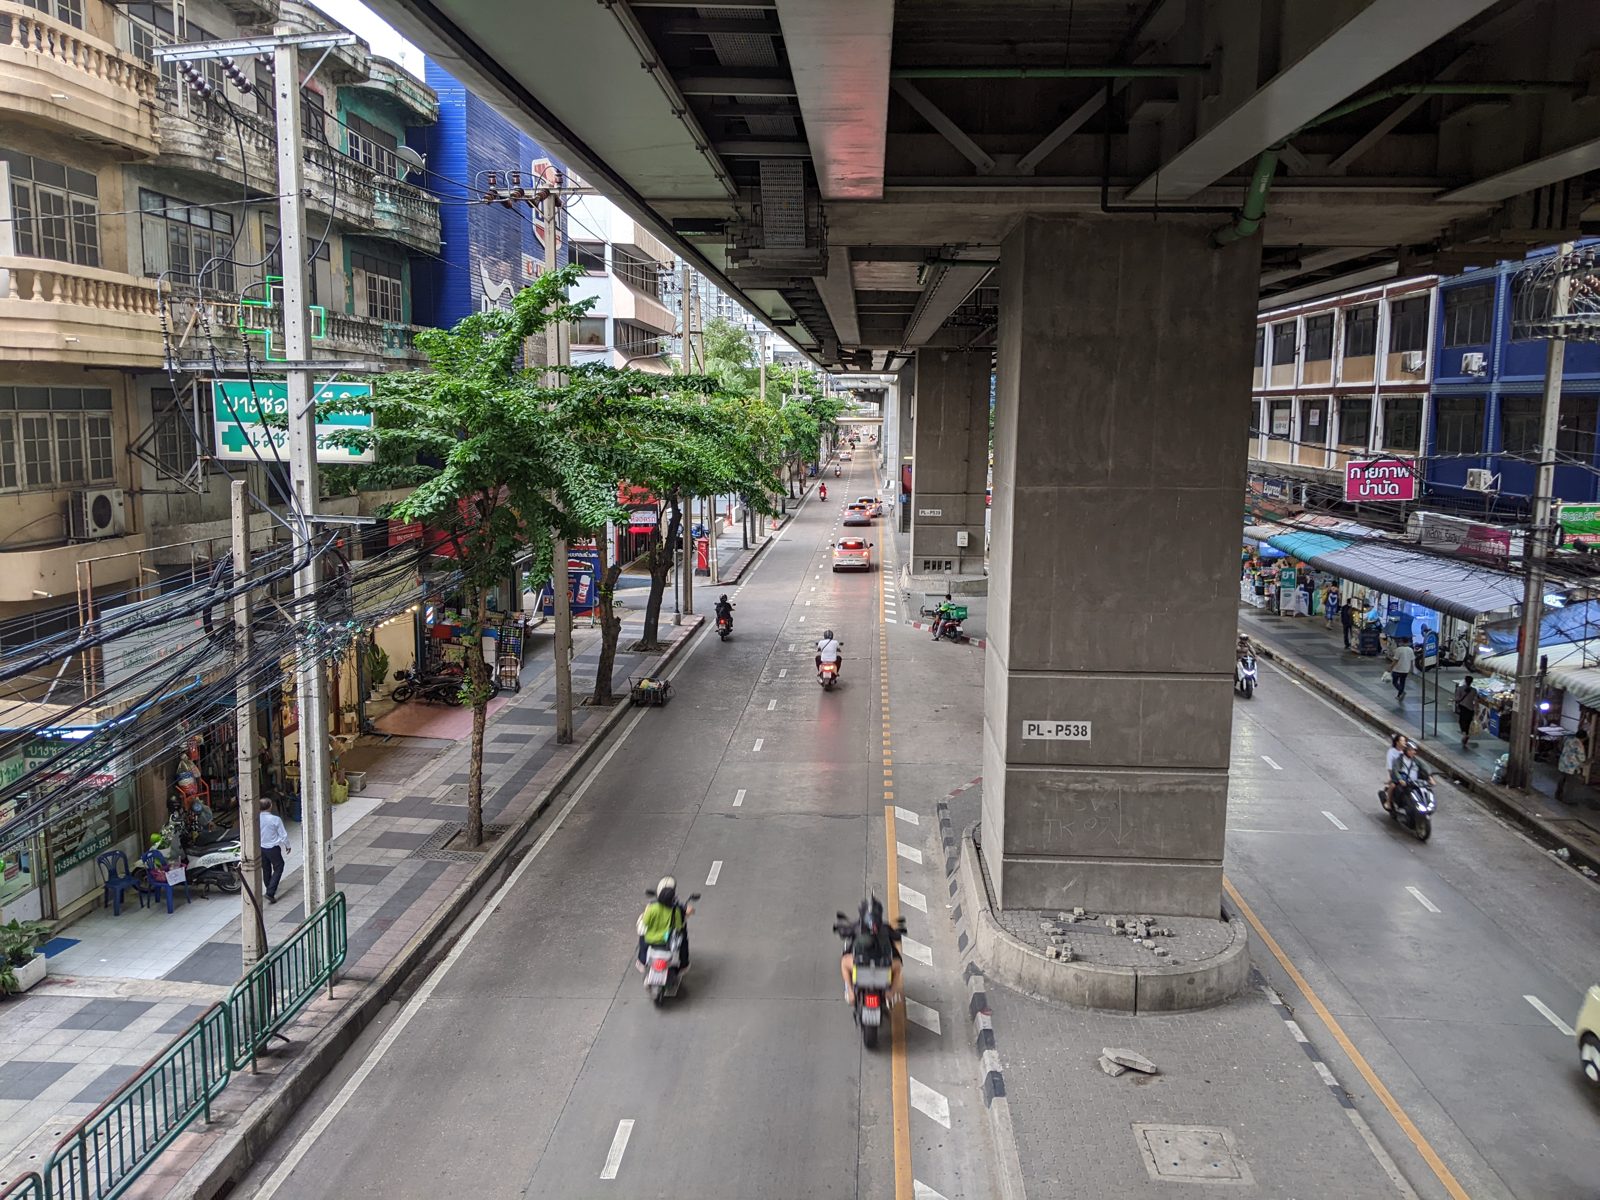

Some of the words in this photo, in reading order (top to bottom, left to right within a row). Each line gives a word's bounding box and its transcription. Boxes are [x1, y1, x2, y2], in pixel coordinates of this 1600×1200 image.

[1350, 466, 1410, 479] กายภาพ
[1359, 479, 1399, 496] บำบัด
[1282, 570, 1295, 580] ยา
[1027, 723, 1044, 736] PL
[1055, 724, 1088, 737] P538
